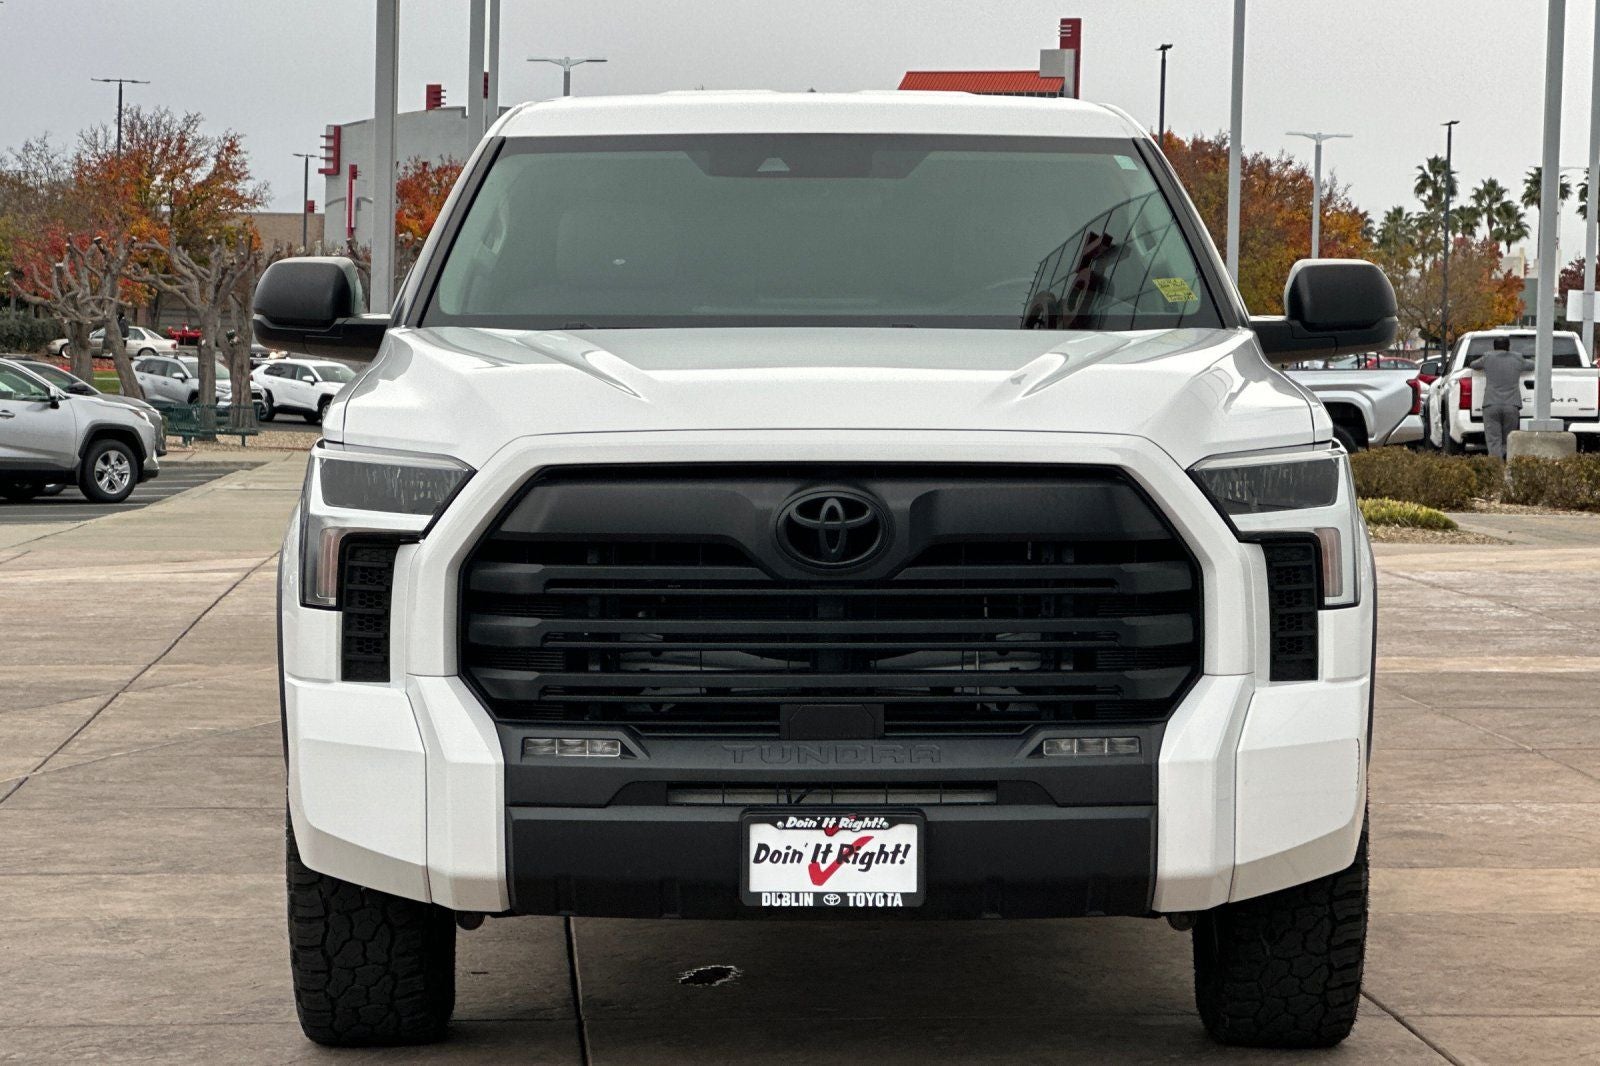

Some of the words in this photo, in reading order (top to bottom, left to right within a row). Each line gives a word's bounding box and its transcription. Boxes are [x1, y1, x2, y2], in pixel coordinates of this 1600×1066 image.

[722, 744, 942, 764] TUNDRA
[786, 816, 820, 829] Doin'
[822, 816, 834, 829] It
[838, 816, 885, 832] Right!
[753, 842, 808, 864] Doin'
[811, 842, 833, 864] It
[837, 842, 911, 872] Right!
[762, 892, 814, 907] DUBLIN
[847, 892, 903, 907] TOYOTA
